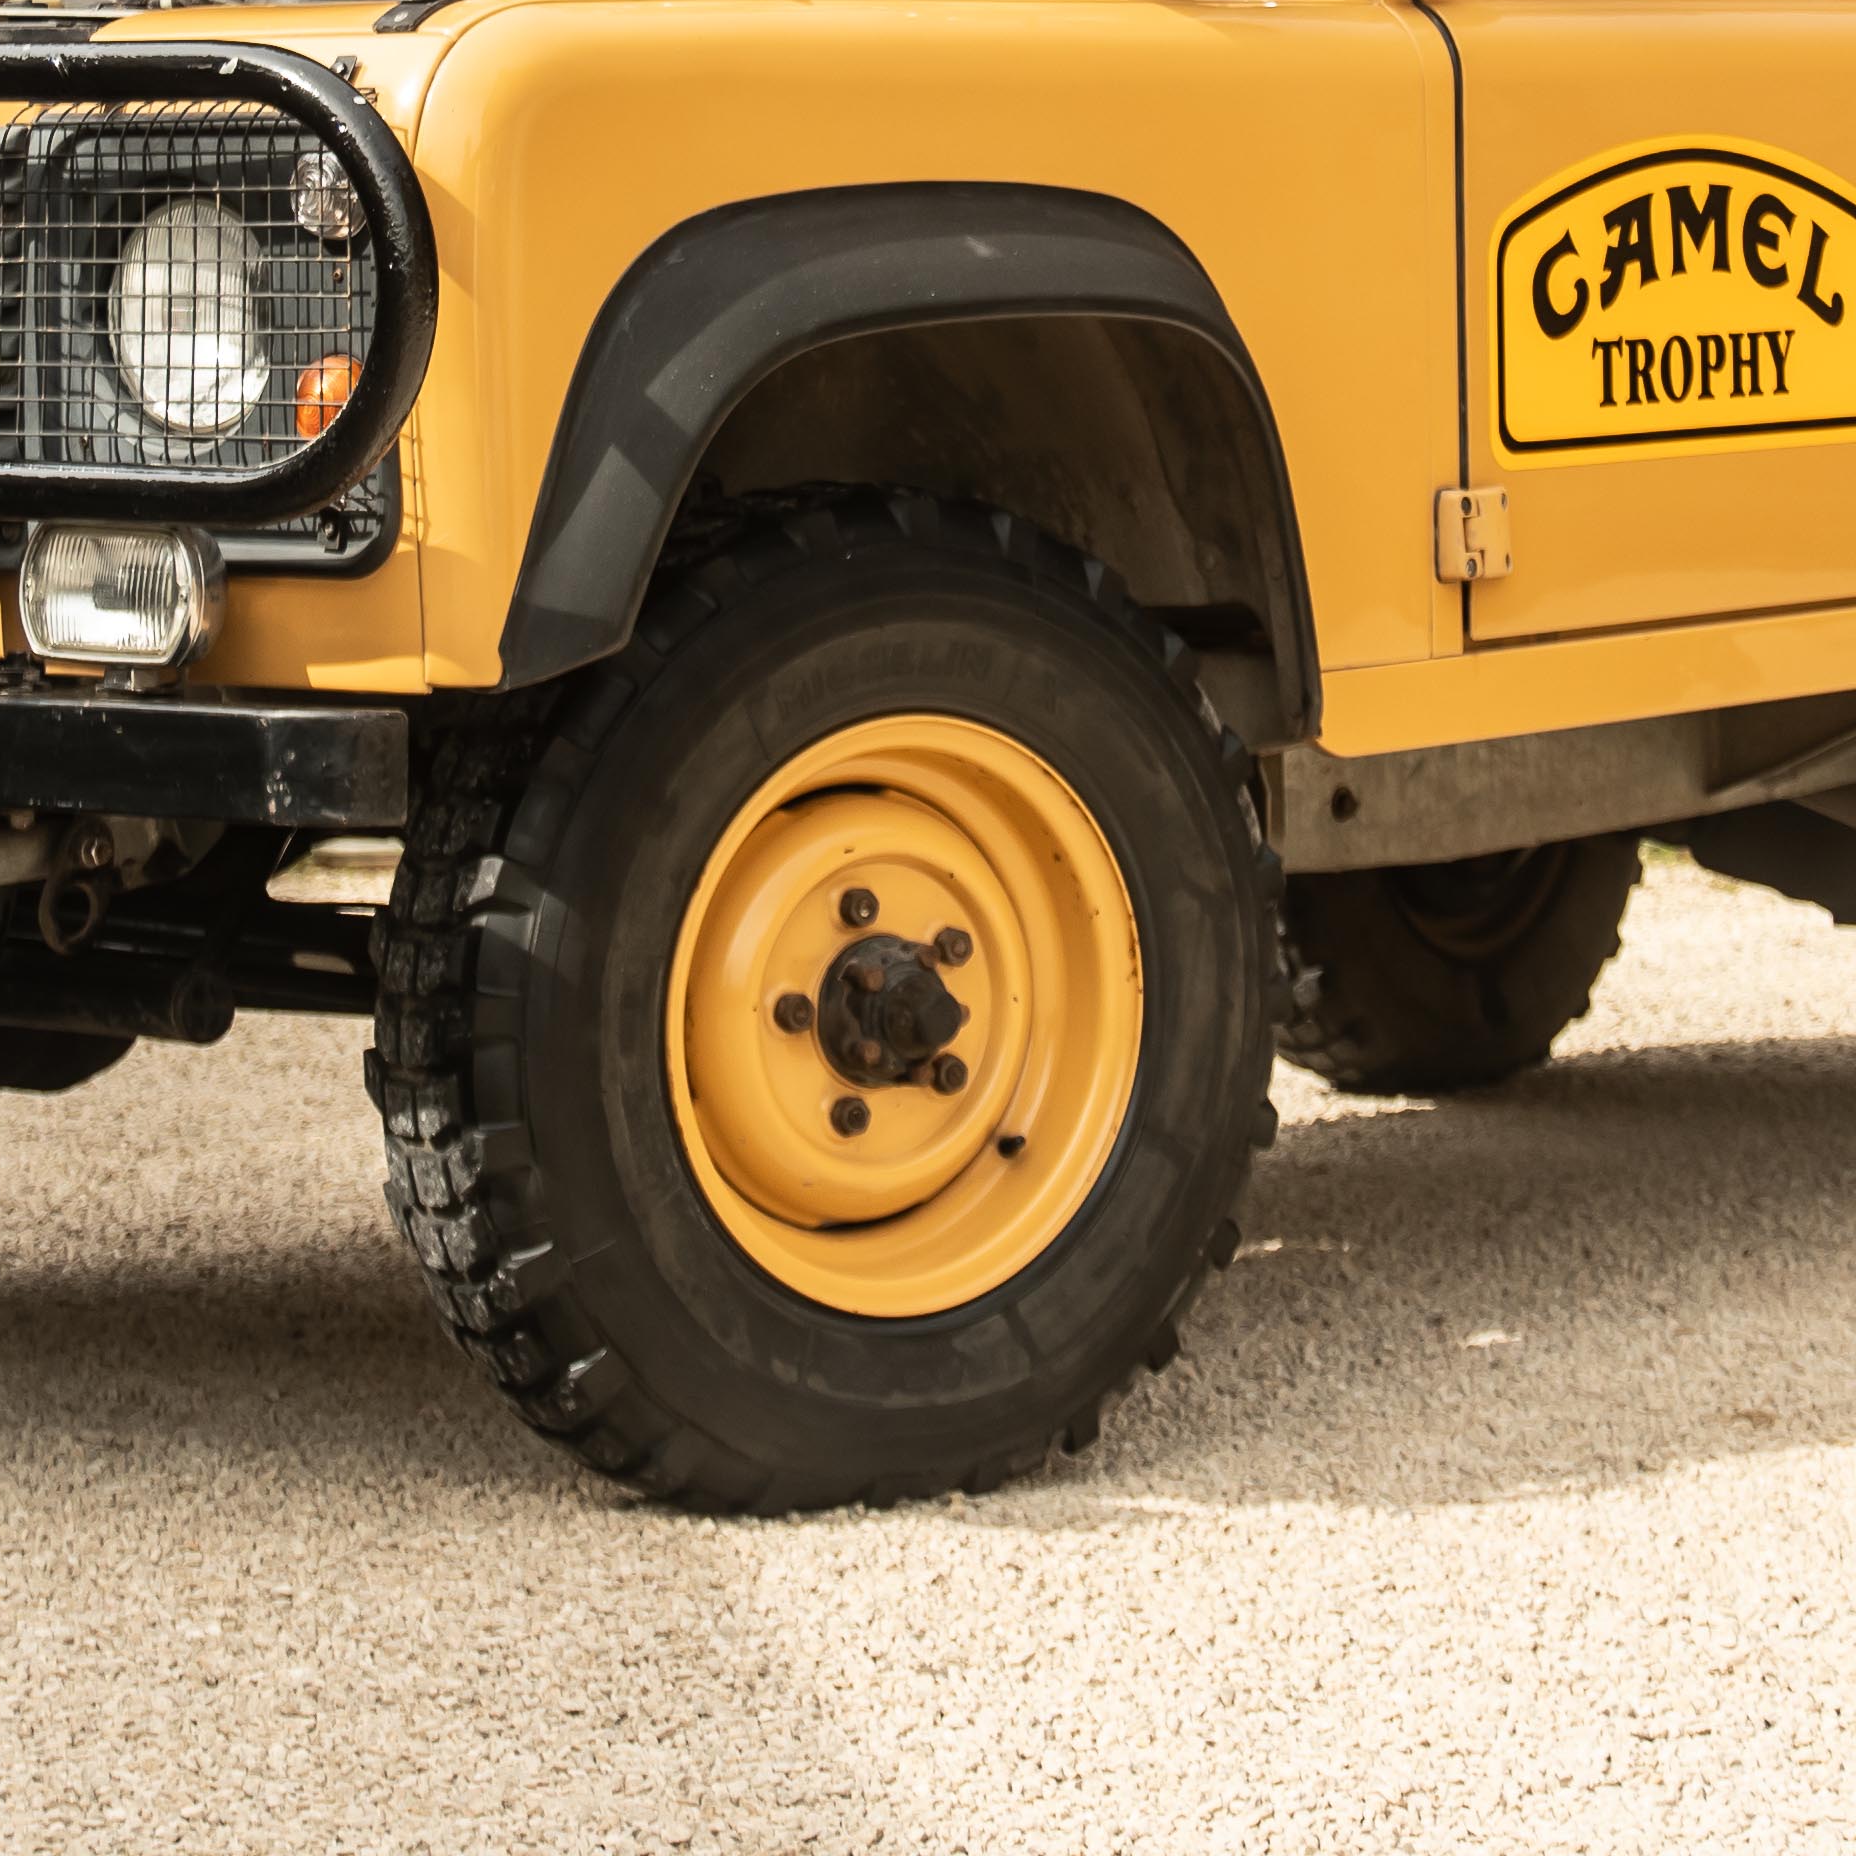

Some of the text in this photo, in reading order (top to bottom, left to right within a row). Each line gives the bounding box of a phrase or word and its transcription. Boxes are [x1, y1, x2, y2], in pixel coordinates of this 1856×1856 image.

[1532, 184, 1845, 340] CAMEL
[1591, 330, 1796, 408] TROPHY
[773, 640, 996, 720] MICHELIN
